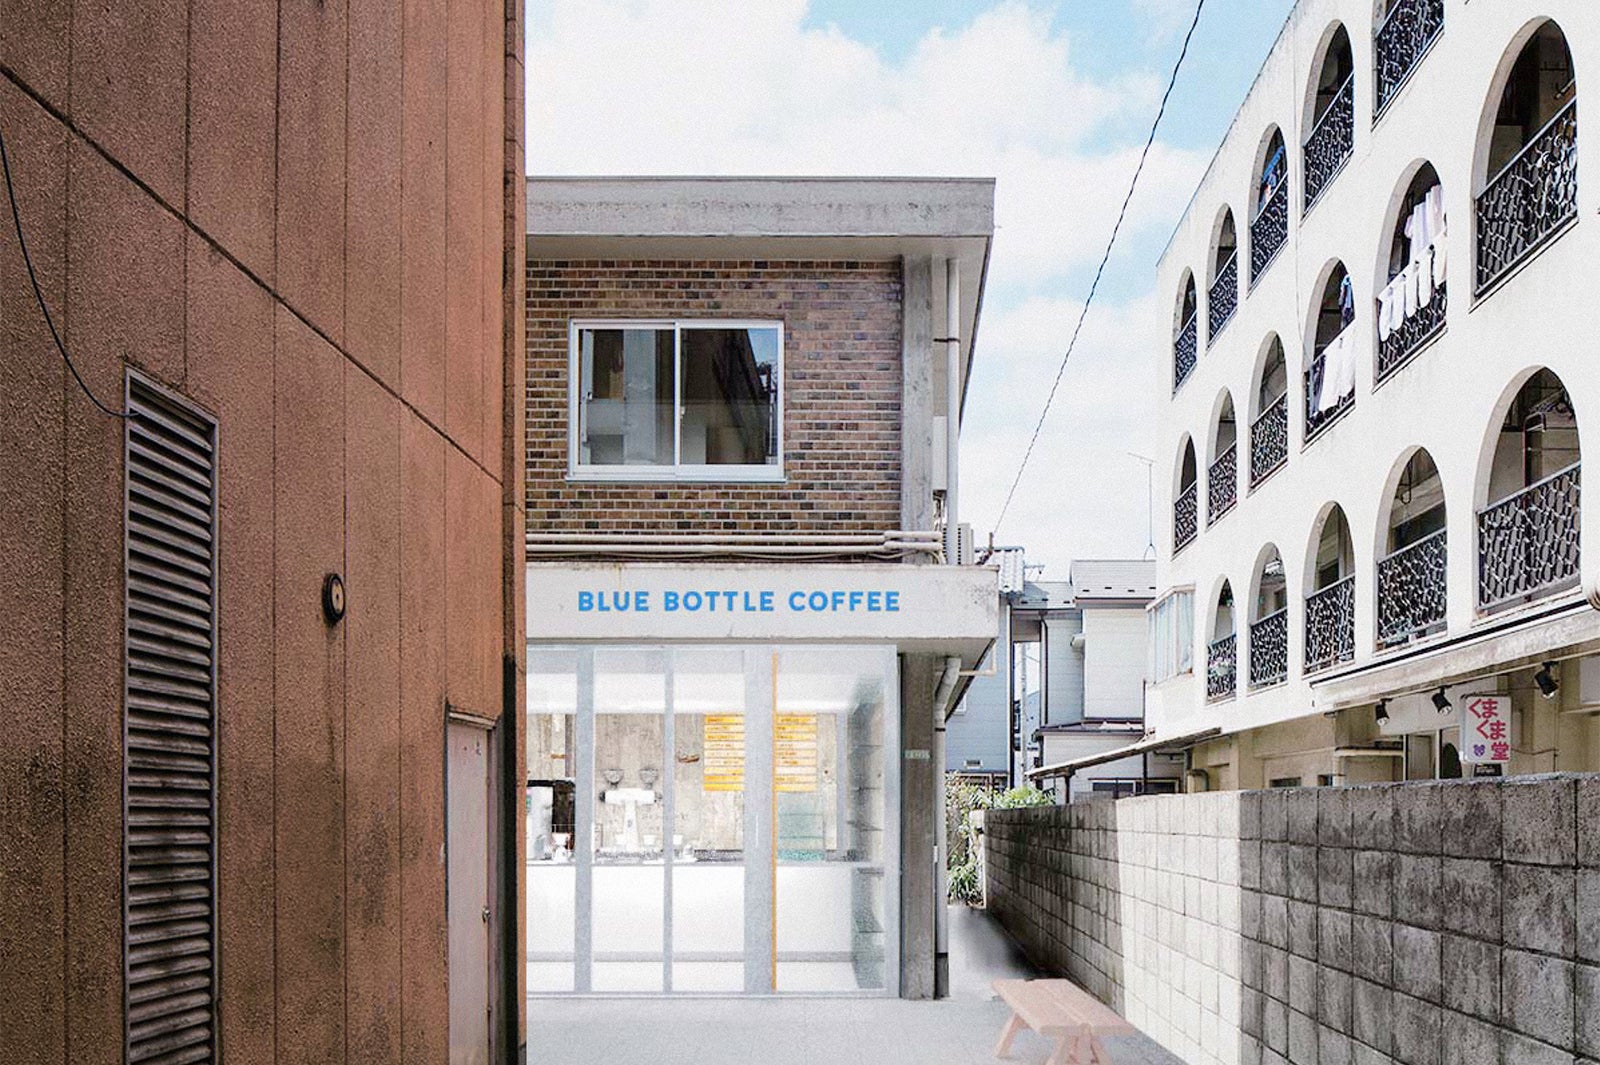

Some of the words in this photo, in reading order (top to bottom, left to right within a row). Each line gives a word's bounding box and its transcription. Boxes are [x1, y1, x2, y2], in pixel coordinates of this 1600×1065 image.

[578, 591, 649, 612] BLUE
[664, 591, 774, 612] BOTTLE
[788, 591, 900, 612] COFFEE
[1469, 698, 1498, 719] くま
[1476, 719, 1506, 740] くま
[1491, 741, 1510, 761] 堂
